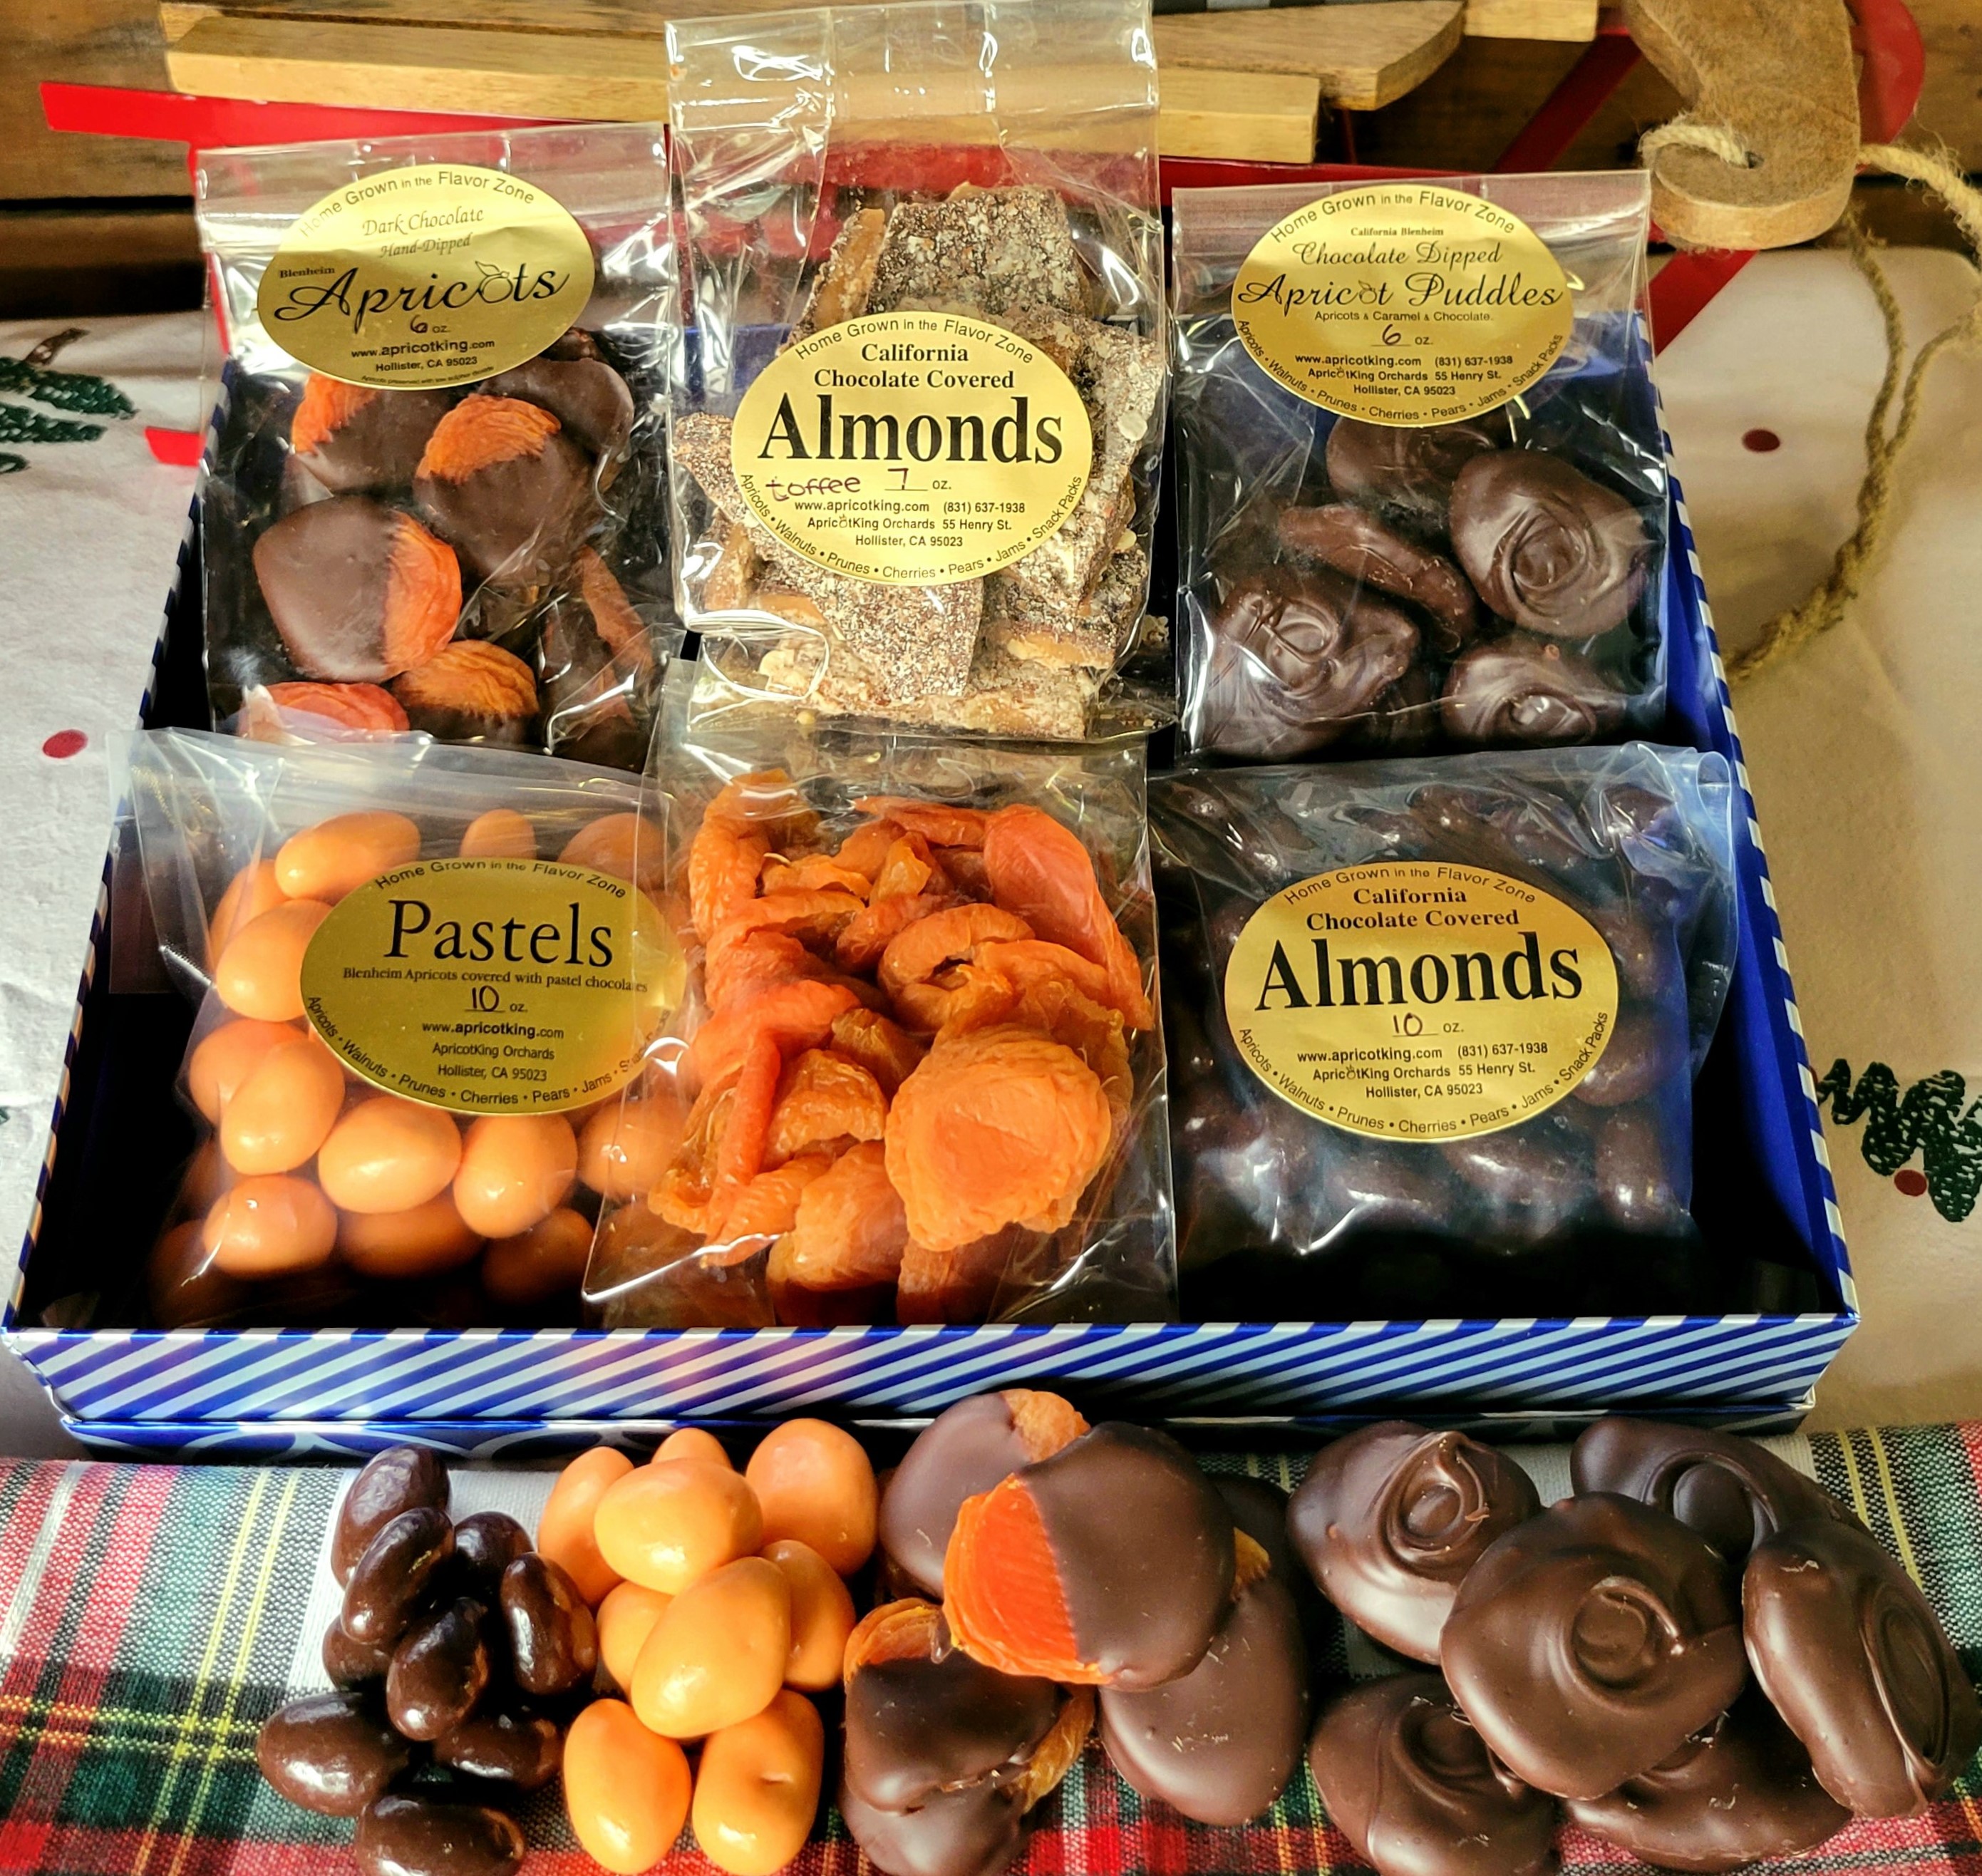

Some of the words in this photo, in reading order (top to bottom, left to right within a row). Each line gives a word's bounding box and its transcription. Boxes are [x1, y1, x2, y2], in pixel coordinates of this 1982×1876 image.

[299, 200, 343, 237] Home
[345, 180, 398, 205] Grown
[401, 178, 411, 188] in
[413, 176, 432, 185] the
[438, 172, 490, 188] Flavor
[493, 177, 535, 204] Zone
[362, 215, 408, 237] Dark
[408, 206, 484, 232] Chocolate
[1271, 211, 1318, 243] Home
[1321, 195, 1376, 215] Grown
[1381, 195, 1392, 205] in
[1395, 193, 1413, 204] the
[1420, 192, 1472, 213] Flavor
[1475, 205, 1514, 234] Zone
[1351, 227, 1397, 237] California
[1401, 227, 1444, 237] Blenheim
[380, 233, 472, 259] Hand-Dipped
[1292, 241, 1409, 265] Chocolate
[1416, 241, 1502, 271] Dipped
[279, 266, 336, 279] Blenheim
[274, 261, 570, 334] Apricots
[1237, 273, 1395, 316] Apricot
[1405, 272, 1564, 306] Puddles
[411, 314, 428, 334] 6
[1315, 311, 1360, 323] Apricots
[1373, 311, 1420, 321] Caramel
[795, 331, 842, 360] Home
[847, 319, 899, 337] Grown
[903, 319, 914, 329] in
[919, 319, 937, 331] the
[944, 320, 993, 343] Flavor
[994, 335, 1033, 364] Zone
[1382, 324, 1402, 346] 6
[1415, 335, 1433, 346] oz.
[351, 339, 495, 359] www.apricotking.com
[862, 344, 969, 362] California
[376, 361, 423, 372] Hollister,
[427, 359, 443, 368] CA
[446, 356, 478, 366] 95023
[1238, 319, 1265, 358] Apricots
[1268, 358, 1308, 392] Walnuts
[1317, 390, 1358, 412] Prunes
[1368, 406, 1420, 420] Cherries
[1432, 403, 1467, 419] Pears
[1477, 387, 1507, 408] Jams
[1512, 356, 1544, 386] Snack
[1538, 334, 1564, 361] Packs
[1294, 354, 1422, 368] www.apricotking.com
[1435, 356, 1461, 368] (831)
[1465, 355, 1513, 367] 637-1938
[815, 369, 919, 388] Chocolate
[927, 371, 1014, 389] Covered
[1378, 370, 1428, 381] Orchards
[1435, 371, 1447, 381] 55
[1451, 370, 1483, 383] Henry
[1487, 369, 1502, 380] St.
[1354, 385, 1400, 396] Hollister,
[1404, 385, 1420, 396] CA
[1423, 385, 1456, 396] 95023
[758, 392, 1062, 464] Almonds
[765, 474, 861, 501] toffee
[887, 468, 909, 490] 7
[932, 479, 951, 490] oz.
[795, 500, 929, 514] www.apricotking.com
[944, 501, 971, 514] (831)
[974, 502, 1025, 513] 637-1938
[740, 473, 771, 517] Apricots
[775, 519, 817, 556] Walnuts
[827, 552, 869, 574] Prunes
[882, 567, 936, 579] Cherries
[949, 557, 984, 575] Pears
[995, 540, 1026, 562] Jams
[1032, 509, 1065, 539] Snack
[1059, 475, 1082, 514] Packs
[807, 515, 879, 531] ApricotKing
[882, 518, 935, 530] Orchards
[942, 519, 956, 530] 55
[959, 519, 993, 532] Henry
[996, 519, 1012, 530] St.
[855, 535, 905, 547] Hollister,
[909, 535, 927, 547] CA
[929, 536, 963, 547] 95023
[375, 865, 426, 890] Home
[430, 860, 487, 872] Grown
[490, 860, 502, 870] in
[506, 860, 527, 871] the
[533, 863, 584, 881] Flavor
[586, 874, 626, 899] Zone
[1284, 876, 1332, 905] Home
[1336, 867, 1390, 884] Grown
[1394, 867, 1406, 877] in
[1410, 867, 1430, 877] the
[1437, 867, 1490, 886] Flavor
[1493, 875, 1537, 904] Zone
[1353, 887, 1467, 904] California
[1306, 912, 1418, 932] Chocolate
[1425, 909, 1519, 927] Covered
[383, 899, 614, 968] Pastels
[344, 968, 402, 979] Blenheim
[405, 969, 458, 982] Apricots
[461, 969, 511, 983] covered
[515, 972, 542, 984] with
[546, 974, 582, 989] pastel
[585, 976, 648, 993] chocolaes
[1254, 931, 1583, 1011] Almonds
[472, 985, 500, 1011] 10
[510, 1002, 527, 1013] oz.
[422, 1020, 564, 1039] www.apricotking.com
[1393, 1013, 1423, 1037] 10
[1443, 1021, 1464, 1034] oz.
[308, 996, 338, 1038] Apricots
[342, 1038, 389, 1078] Walnuts
[398, 1073, 446, 1098] Prunes
[460, 1090, 518, 1103] Cherries
[532, 1088, 570, 1103] Pears
[581, 1072, 612, 1093] Jams
[433, 1043, 500, 1058] ApricotKing
[503, 1044, 554, 1060] Orchards
[1297, 1046, 1442, 1063] www.apricotking.com
[1457, 1043, 1488, 1058] (831)
[1492, 1042, 1548, 1056] 637-1938
[438, 1065, 487, 1079] Hollister,
[491, 1066, 508, 1078] CA
[512, 1068, 547, 1081] 95023
[1239, 1028, 1272, 1072] Apricots
[1277, 1073, 1326, 1111] Walnuts
[1337, 1106, 1385, 1130] Prunes
[1398, 1119, 1457, 1133] Cherries
[1470, 1105, 1509, 1126] Pears
[1521, 1083, 1554, 1109] Jams
[1559, 1048, 1594, 1081] Snack
[1586, 1011, 1609, 1053] Packs
[1393, 1065, 1450, 1079] Orchards
[1459, 1064, 1473, 1076] 55
[1477, 1063, 1514, 1077] Henry
[1518, 1061, 1535, 1073] St.
[1366, 1085, 1420, 1099] Hollister,
[1425, 1084, 1443, 1097] CA
[1447, 1083, 1482, 1096] 95023
